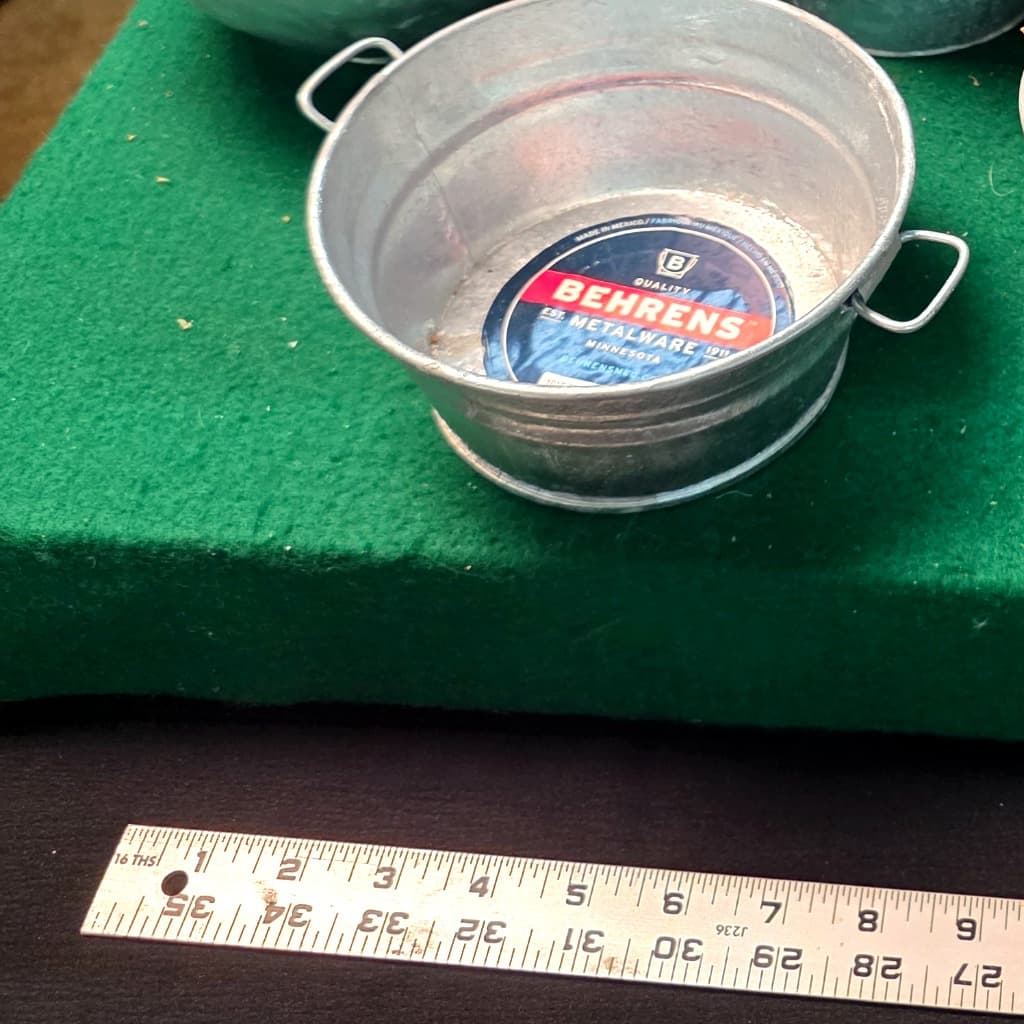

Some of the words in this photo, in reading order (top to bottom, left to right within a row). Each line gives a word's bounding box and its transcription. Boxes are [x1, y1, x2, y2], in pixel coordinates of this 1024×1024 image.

[665, 255, 686, 271] B
[632, 277, 692, 294] QUALITY
[552, 278, 747, 341] BEHRENS
[541, 307, 566, 321] EST.
[569, 314, 698, 355] METALWARE
[584, 338, 662, 365] MINNESOTA
[114, 852, 128, 866] 16
[130, 854, 157, 868] THS
[163, 893, 215, 919] 35
[195, 851, 208, 872] 1
[277, 859, 301, 881] 2
[373, 866, 397, 890] 3
[469, 876, 489, 897] 4
[566, 884, 587, 906] 5
[663, 892, 684, 915] 6
[760, 900, 783, 923] 7
[858, 909, 879, 932] 8
[956, 918, 978, 941] 9
[263, 902, 312, 927] 34
[358, 909, 409, 935] 33
[456, 919, 506, 943] 32
[562, 929, 605, 953] 31
[715, 924, 748, 938] J236
[653, 936, 703, 962] 30
[753, 945, 803, 970] 29
[853, 953, 902, 978] 28
[953, 962, 1002, 988] 27
